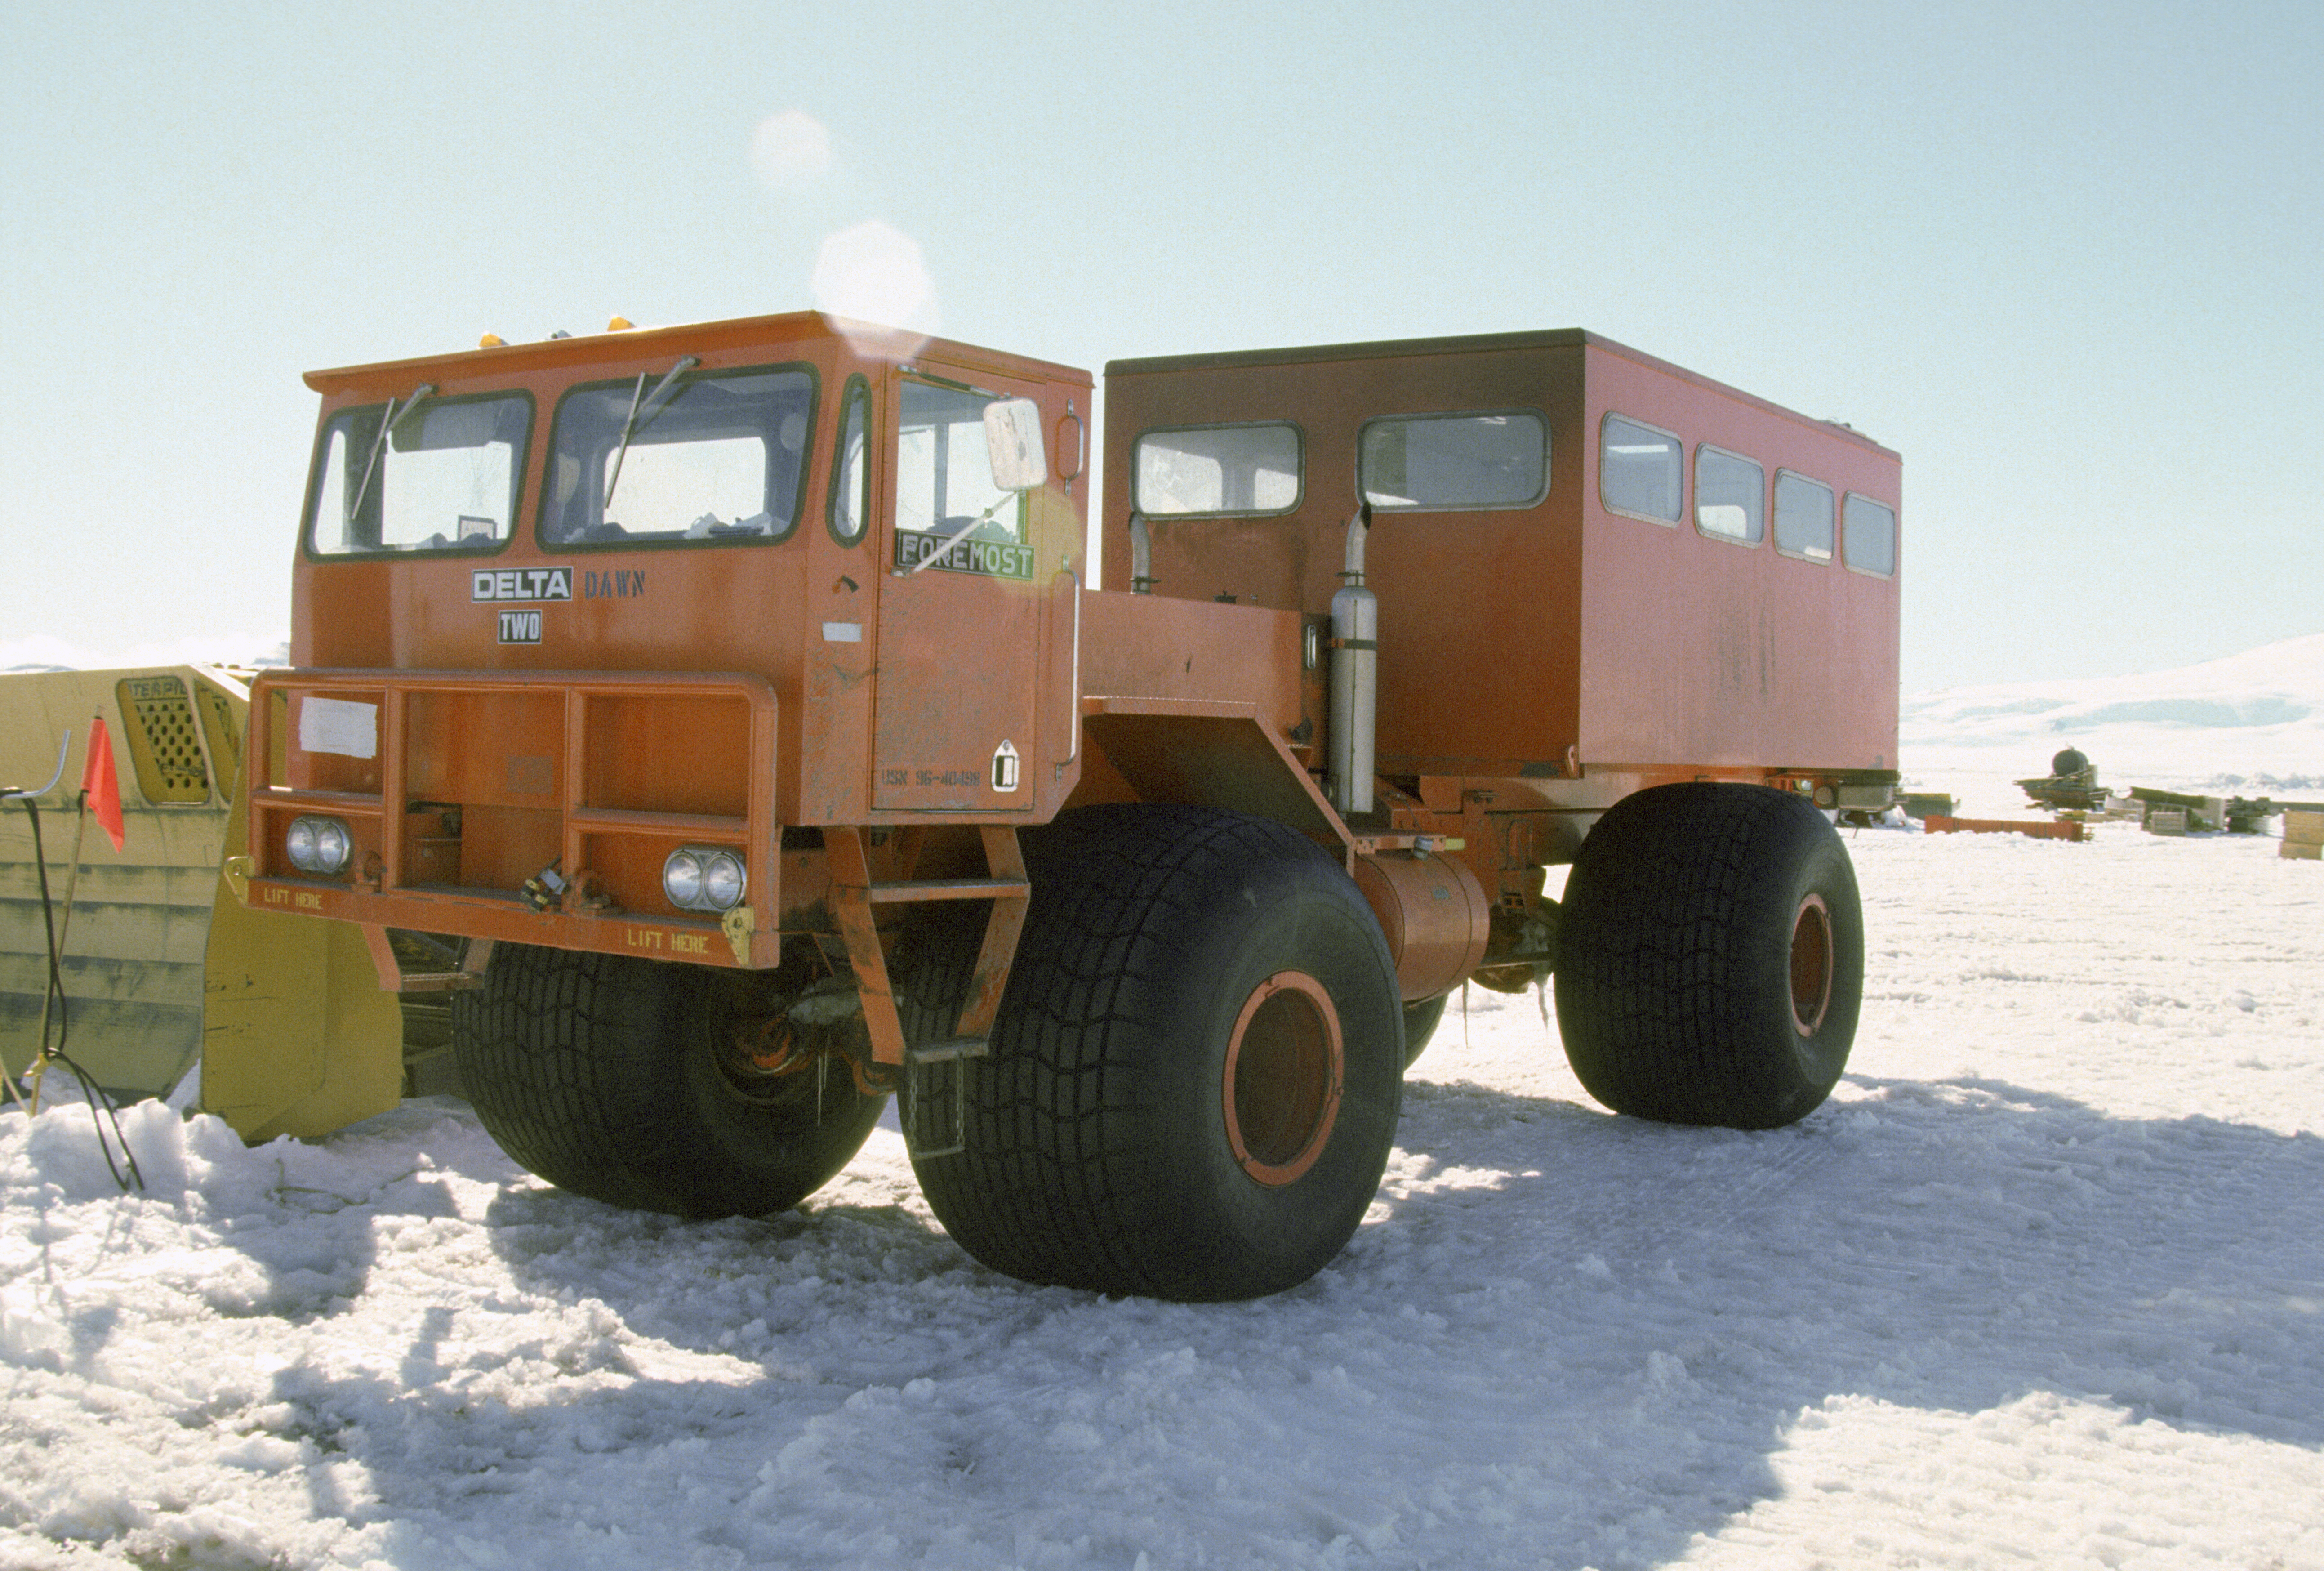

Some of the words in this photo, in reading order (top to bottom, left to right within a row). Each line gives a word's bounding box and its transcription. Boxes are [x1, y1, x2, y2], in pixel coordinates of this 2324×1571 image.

[901, 534, 1032, 576] FOREMOST
[473, 571, 570, 599] DELTA
[585, 570, 645, 598] DAWN
[500, 613, 539, 640] TWO
[264, 887, 289, 905] LIFT
[295, 892, 322, 910] HERE
[628, 928, 663, 949] LIFT
[672, 933, 709, 954] HERE
